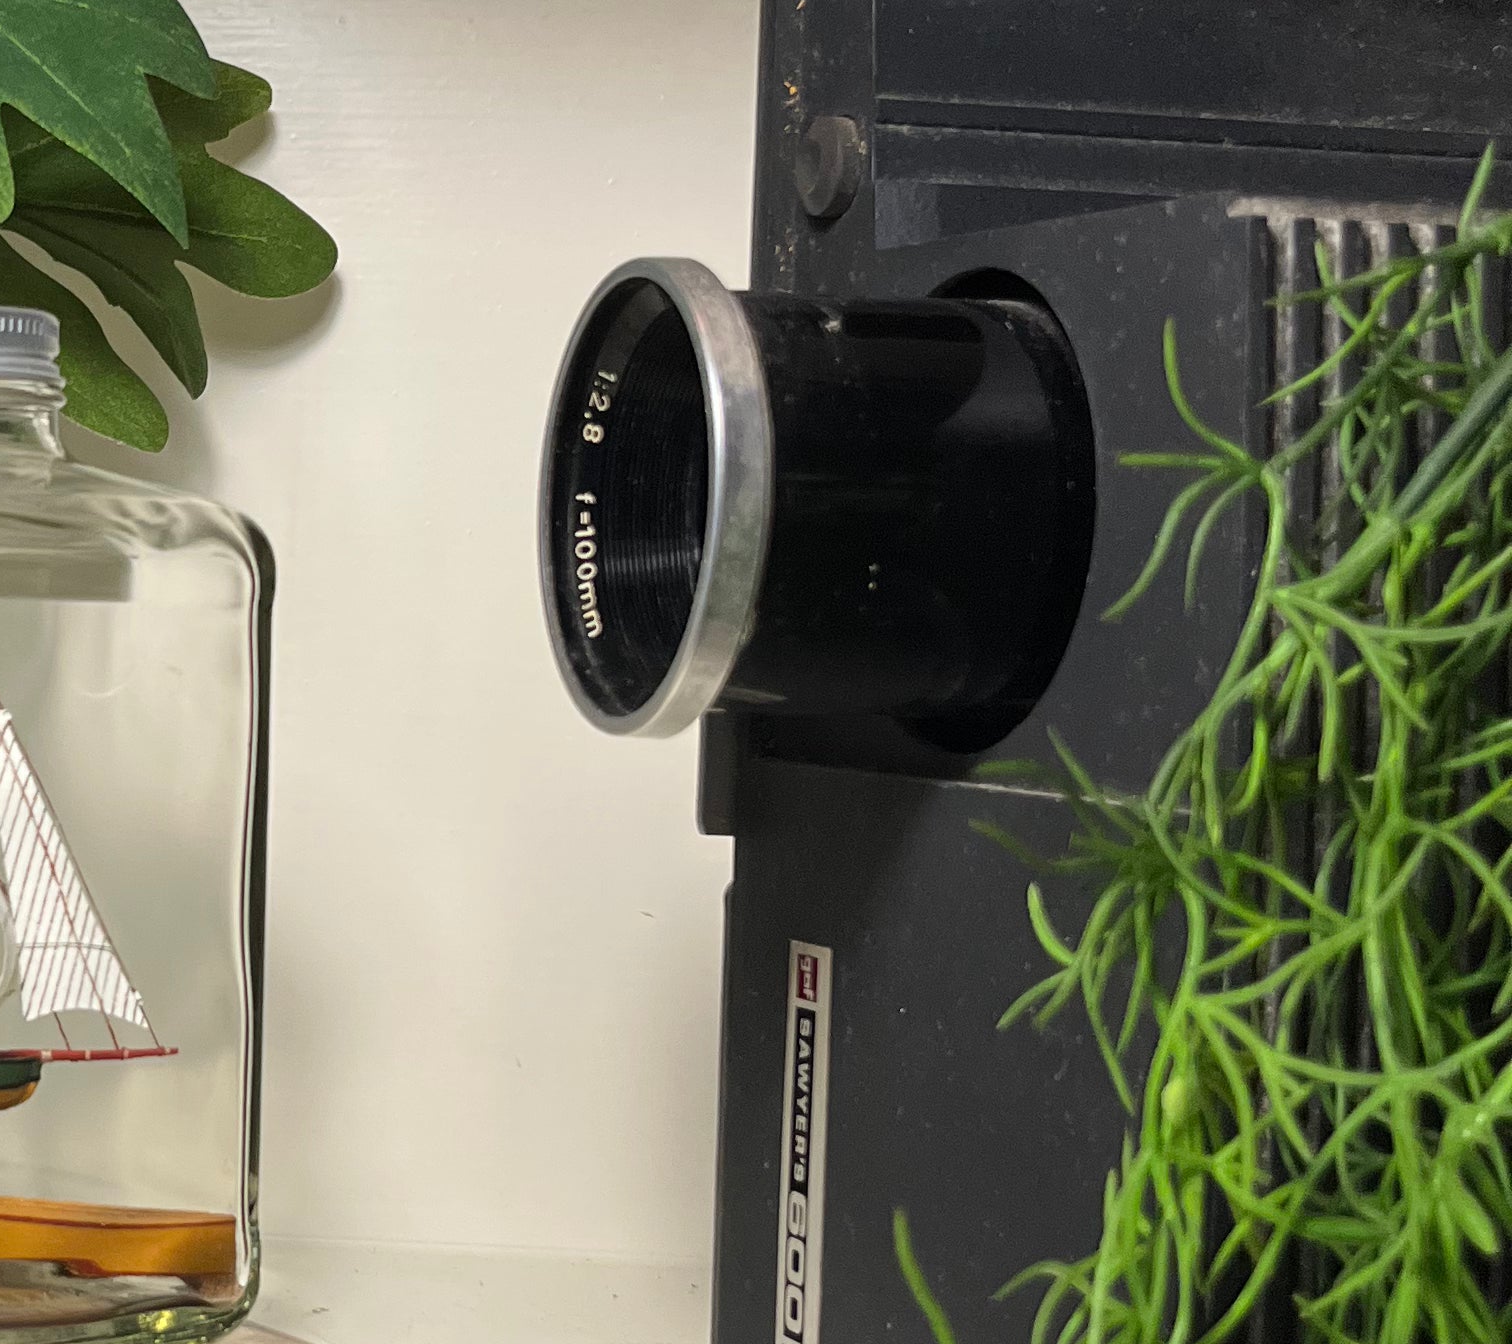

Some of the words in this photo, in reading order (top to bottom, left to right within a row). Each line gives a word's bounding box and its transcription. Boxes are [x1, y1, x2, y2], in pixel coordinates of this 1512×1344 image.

[582, 370, 618, 444] 1:2.8
[798, 956, 816, 1002] gaf
[792, 1017, 812, 1183] SAWYER'S
[783, 1189, 808, 1335] 600
